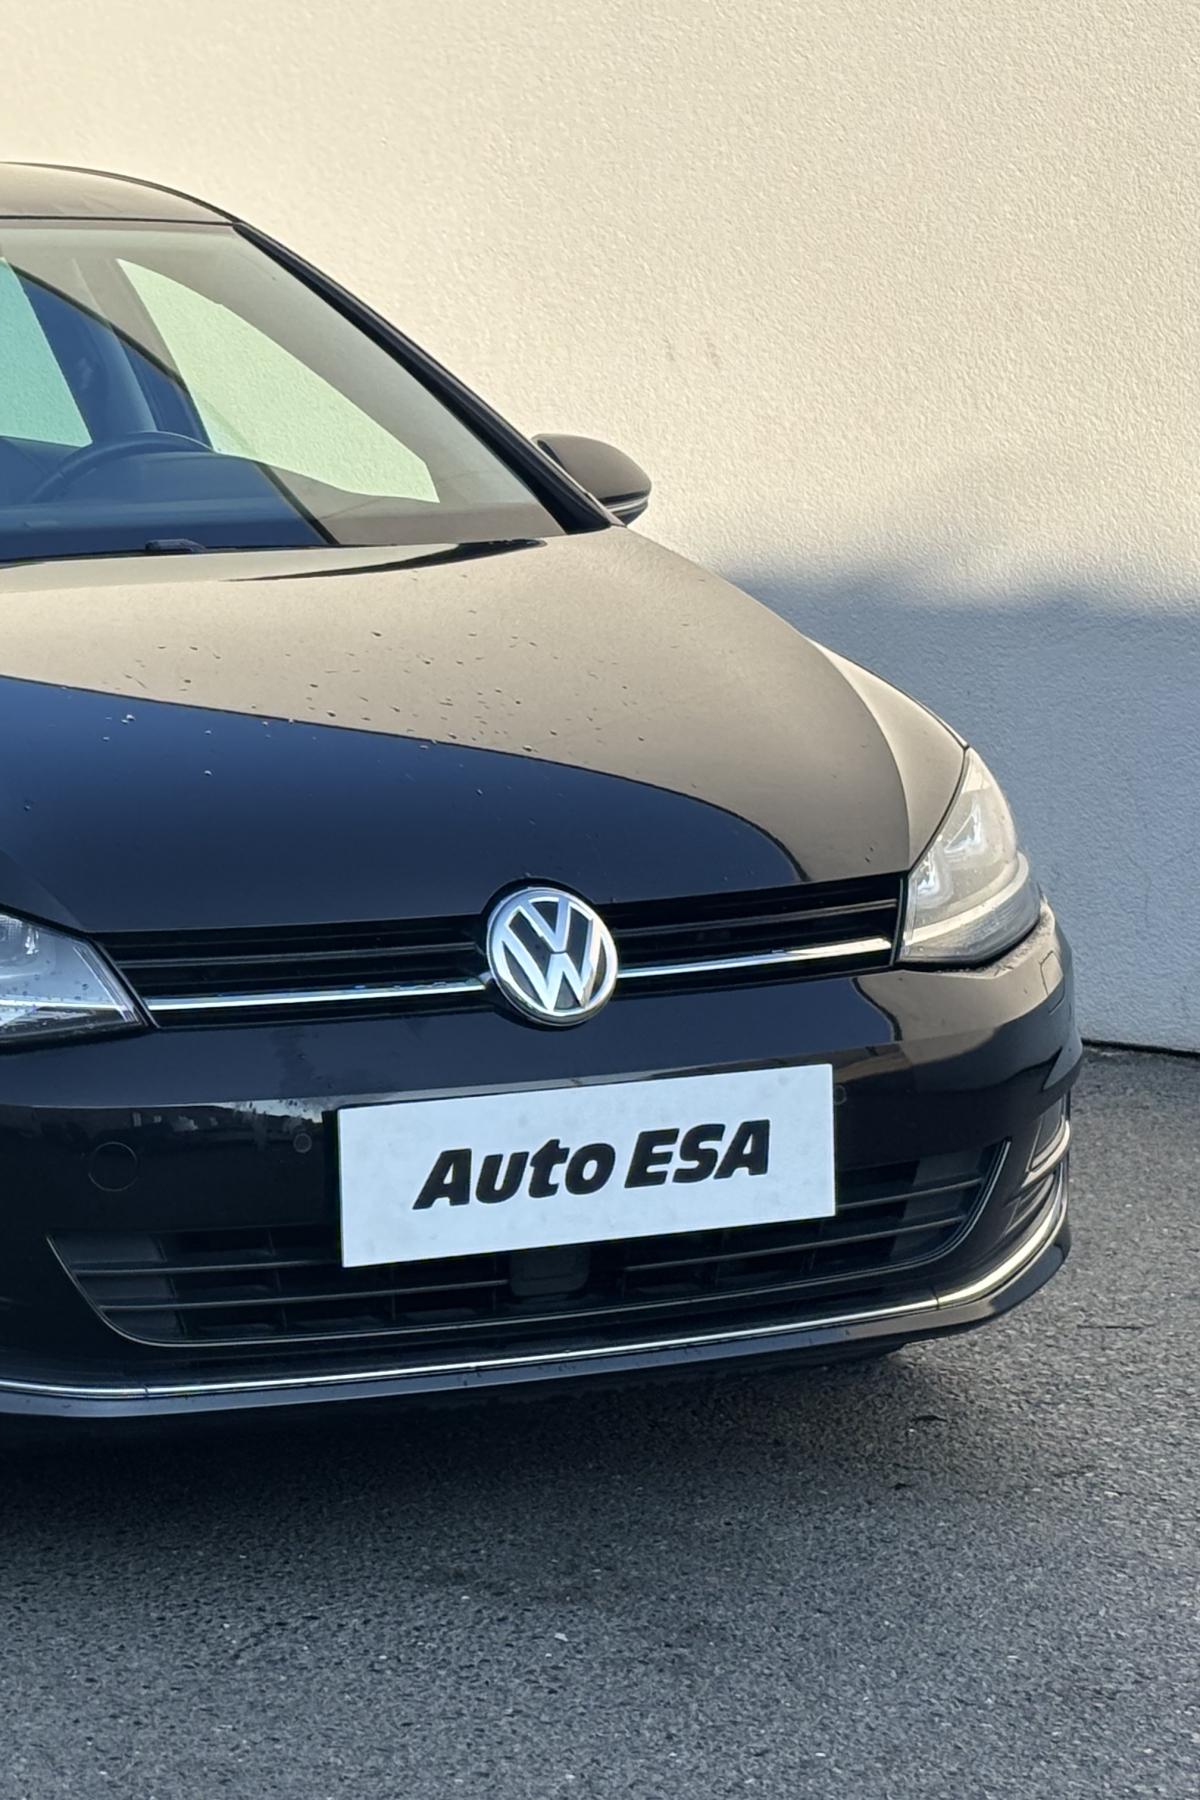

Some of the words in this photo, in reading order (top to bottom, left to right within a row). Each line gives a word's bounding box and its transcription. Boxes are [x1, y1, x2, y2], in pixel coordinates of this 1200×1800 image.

[490, 889, 616, 1022] VW
[412, 1139, 616, 1210] Auto
[624, 1119, 771, 1189] ESA
